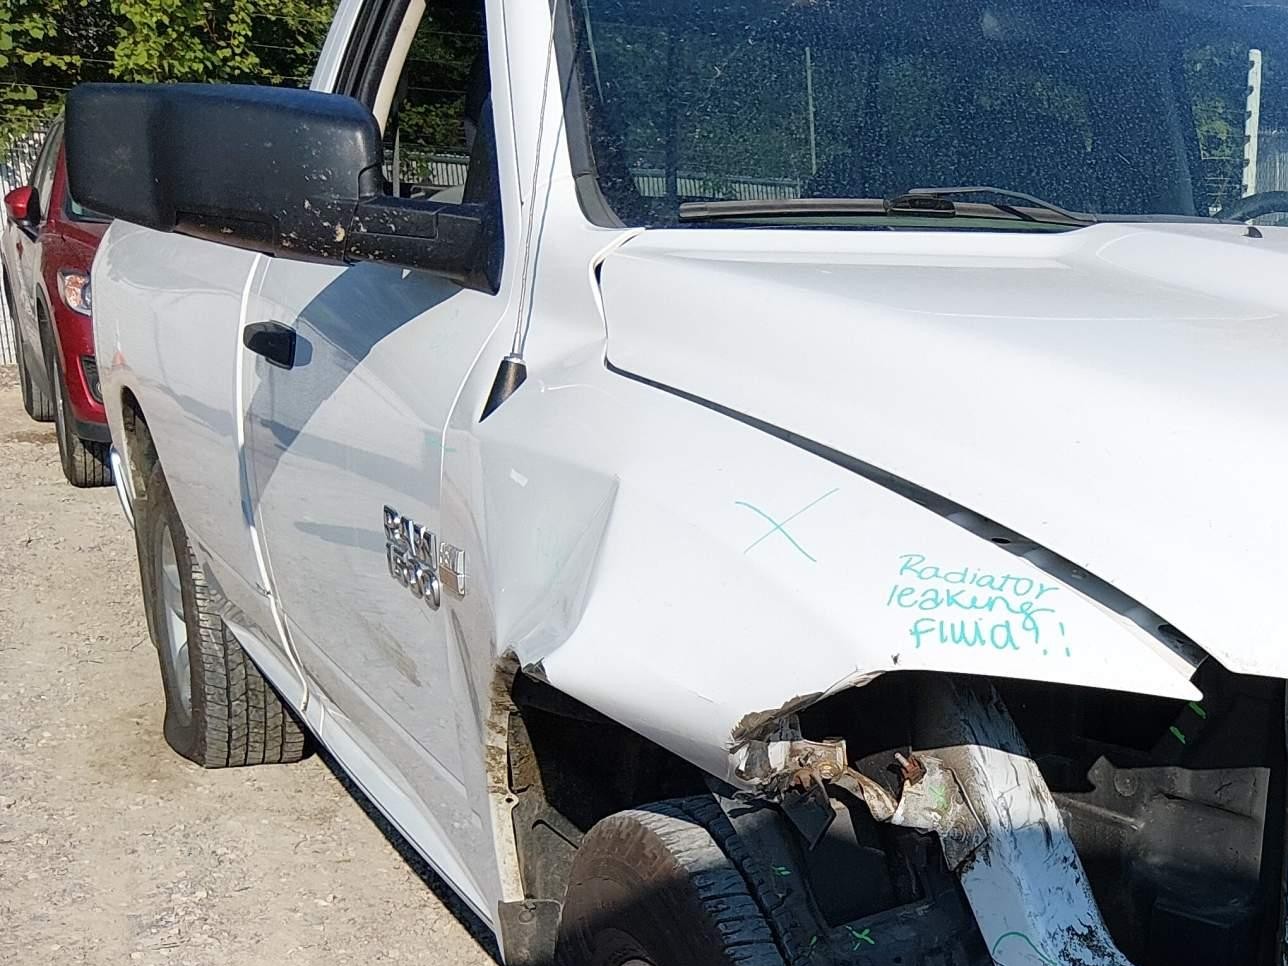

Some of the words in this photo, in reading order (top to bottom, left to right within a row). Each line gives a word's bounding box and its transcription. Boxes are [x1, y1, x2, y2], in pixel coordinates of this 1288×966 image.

[383, 505, 438, 572] RAM
[898, 553, 1060, 600] Radiator
[886, 583, 1056, 632] leaking
